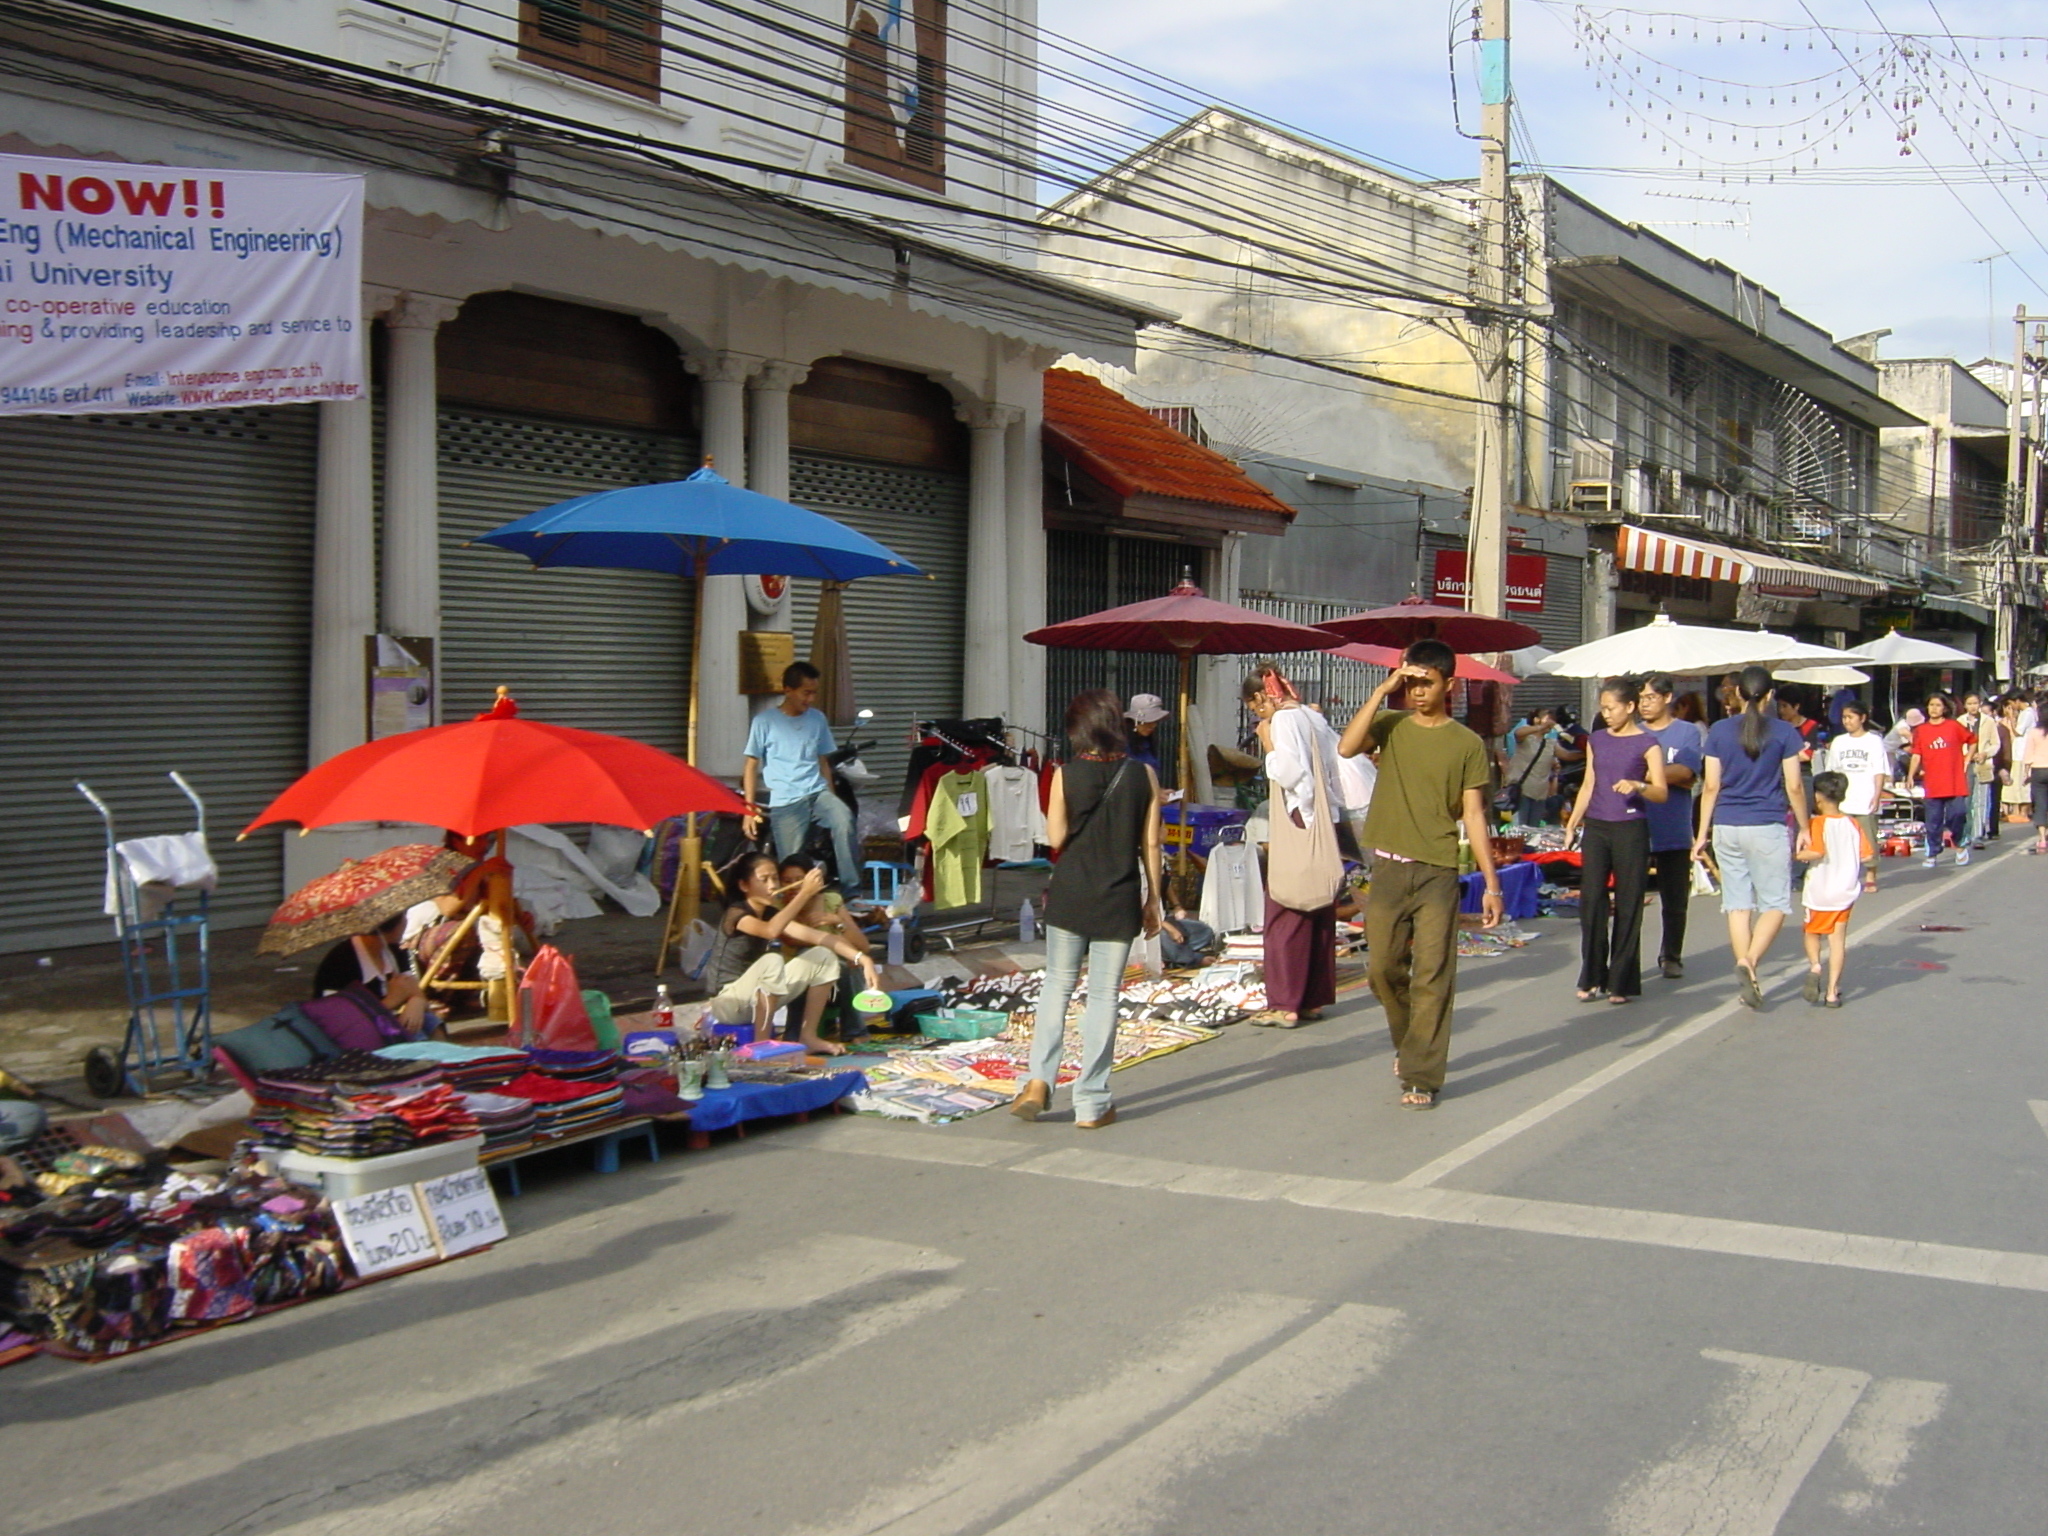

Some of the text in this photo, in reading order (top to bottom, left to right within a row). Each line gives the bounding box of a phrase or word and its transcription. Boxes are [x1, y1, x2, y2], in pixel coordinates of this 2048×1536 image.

[18, 172, 225, 219] NOW!!
[55, 219, 195, 254] (Mechanical
[210, 226, 343, 259] Engineering)
[0, 259, 173, 293] i University
[6, 299, 231, 318] co-operative education
[41, 317, 54, 338] &
[60, 323, 144, 343] providing
[248, 321, 272, 335] and
[281, 319, 331, 334] service
[336, 315, 352, 332] to
